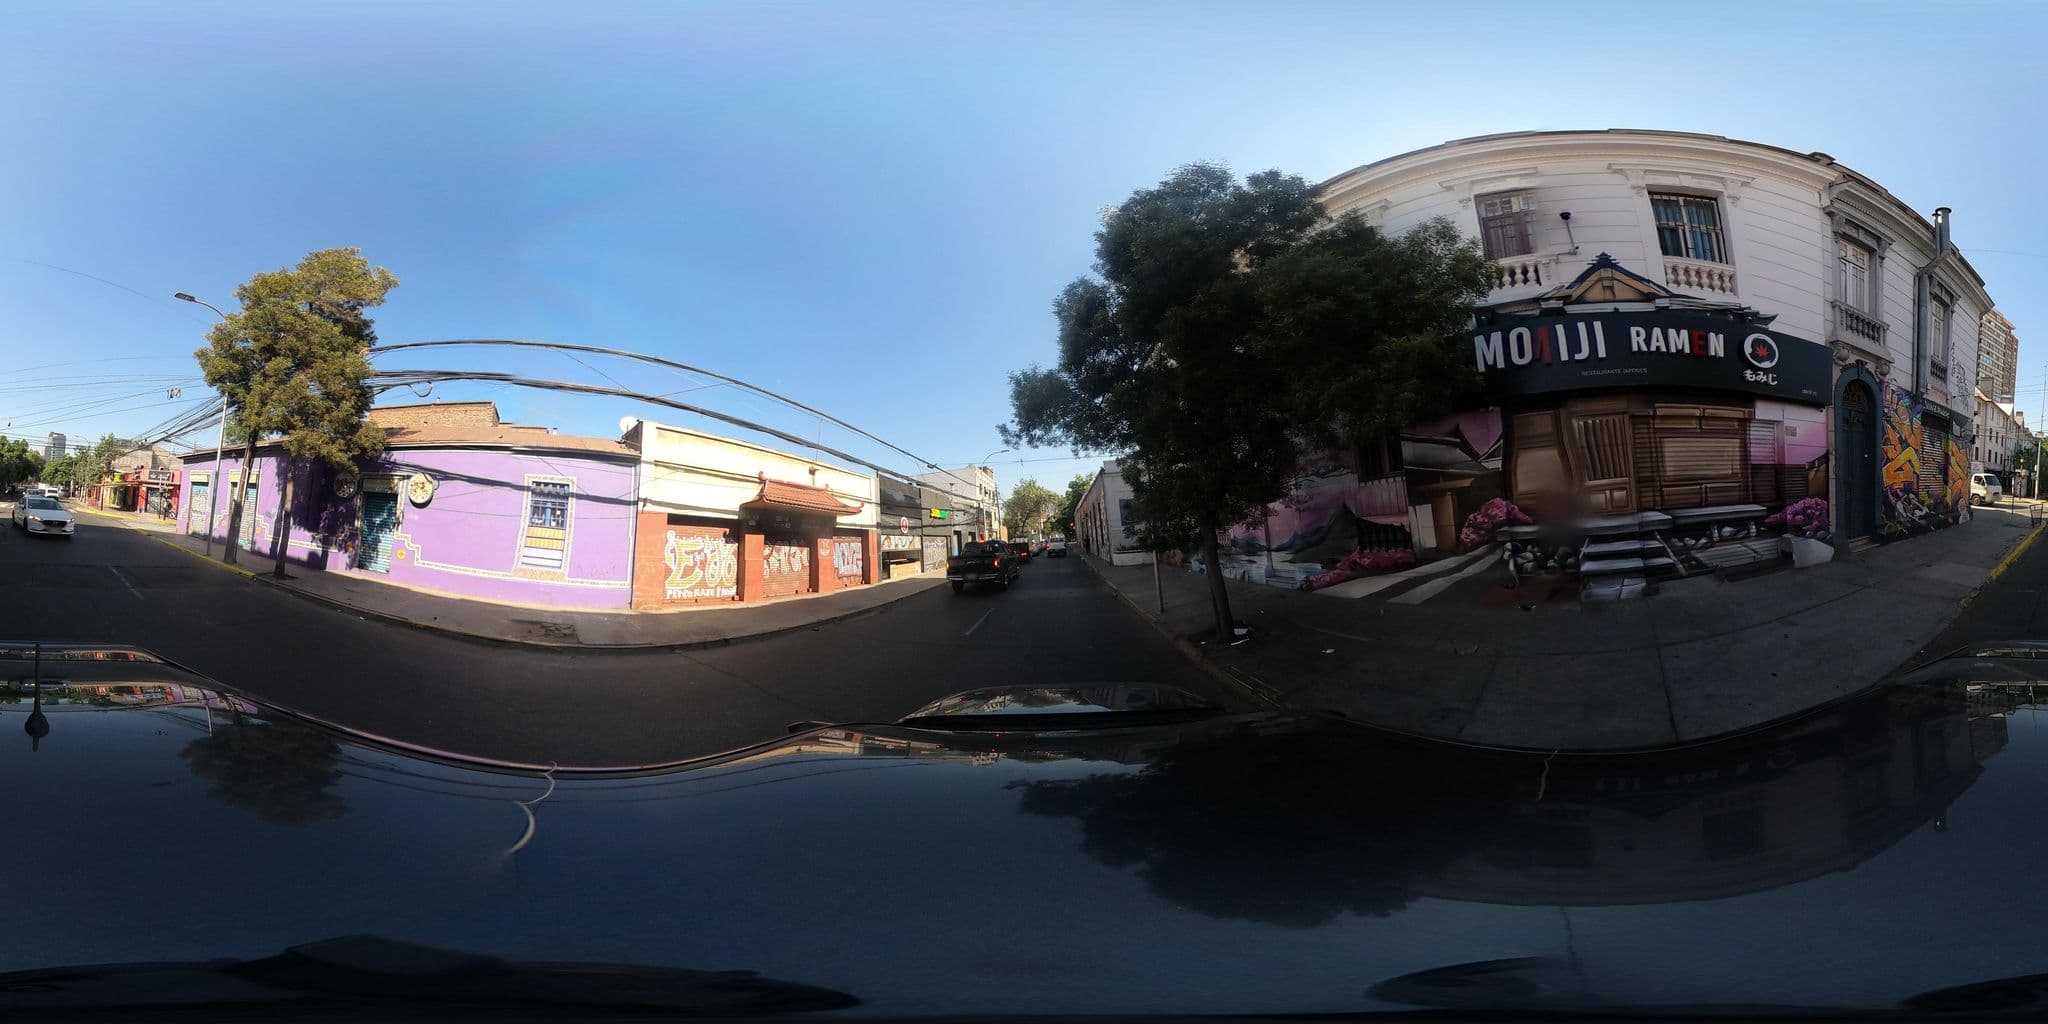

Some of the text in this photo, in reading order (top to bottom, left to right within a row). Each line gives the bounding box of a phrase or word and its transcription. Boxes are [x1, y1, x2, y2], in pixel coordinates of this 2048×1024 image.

[1629, 326, 1725, 358] RAMEN
[1743, 368, 1778, 386] もみじ
